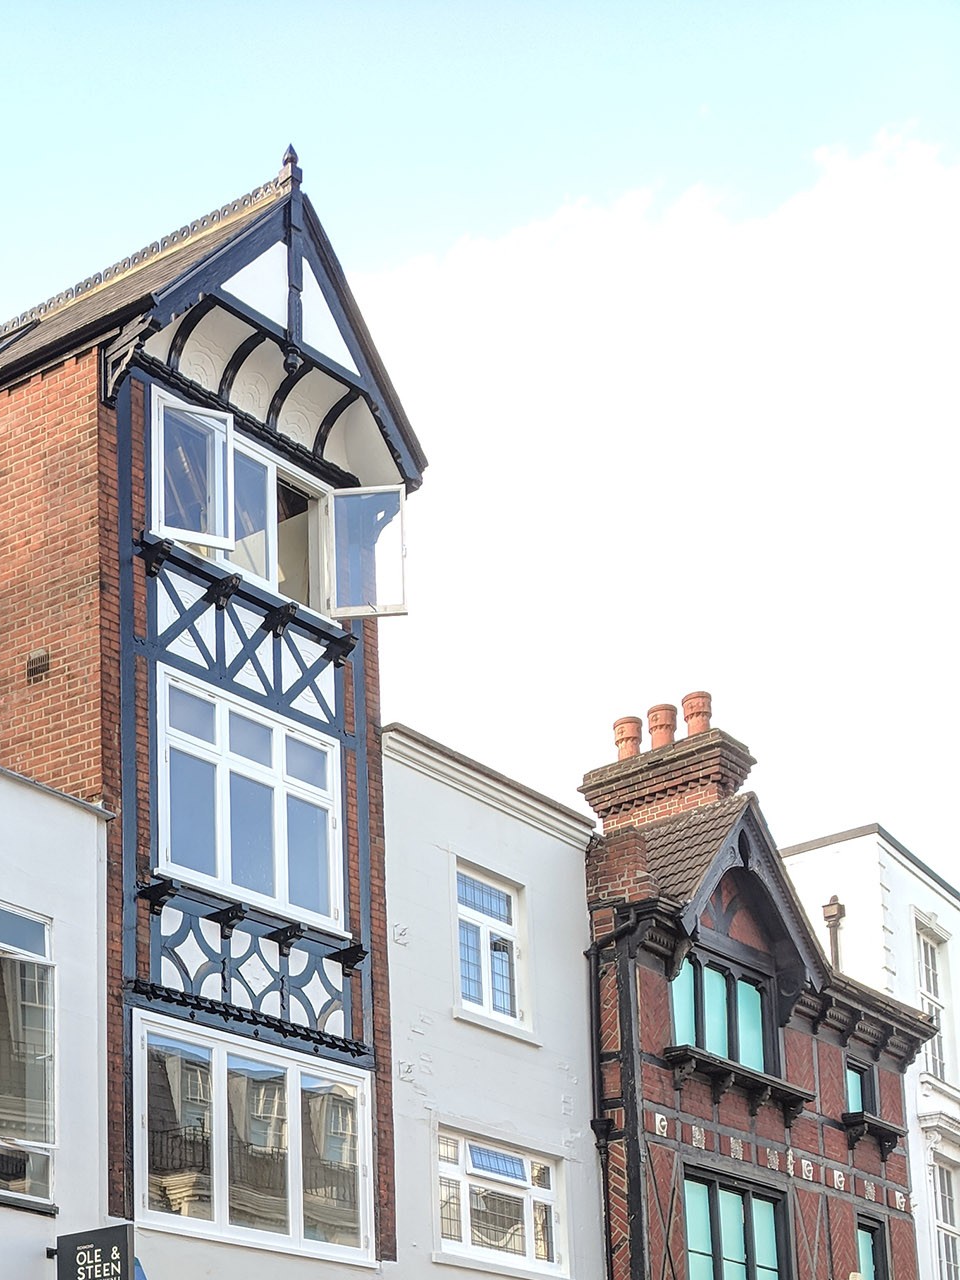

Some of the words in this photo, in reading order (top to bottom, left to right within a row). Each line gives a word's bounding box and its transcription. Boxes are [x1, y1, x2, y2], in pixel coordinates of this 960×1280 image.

[76, 1248, 102, 1266] OLE
[110, 1245, 121, 1260] &
[76, 1261, 121, 1280] STEEN
